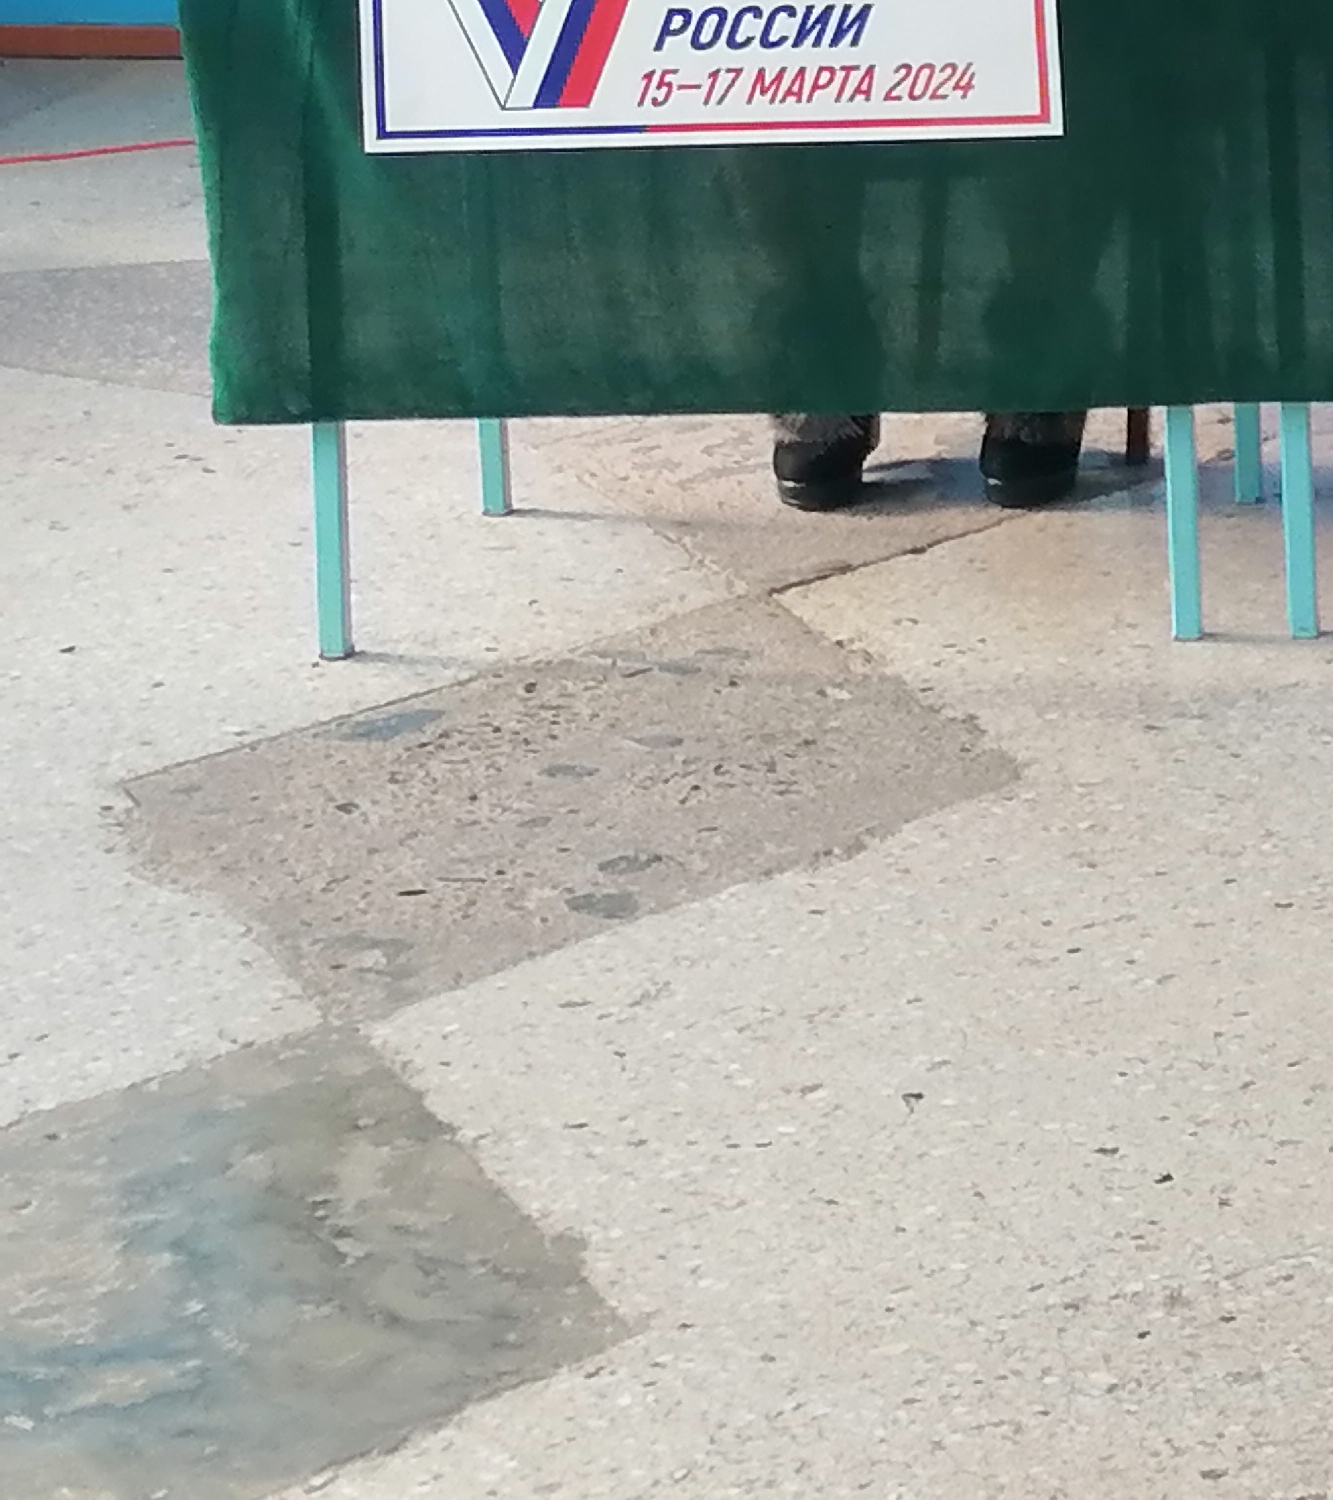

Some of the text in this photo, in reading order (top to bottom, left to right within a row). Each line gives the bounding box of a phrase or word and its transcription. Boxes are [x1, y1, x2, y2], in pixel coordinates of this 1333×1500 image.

[652, 2, 874, 52] РОССИИ
[744, 63, 877, 106] МАРТА
[882, 62, 976, 103] 2024
